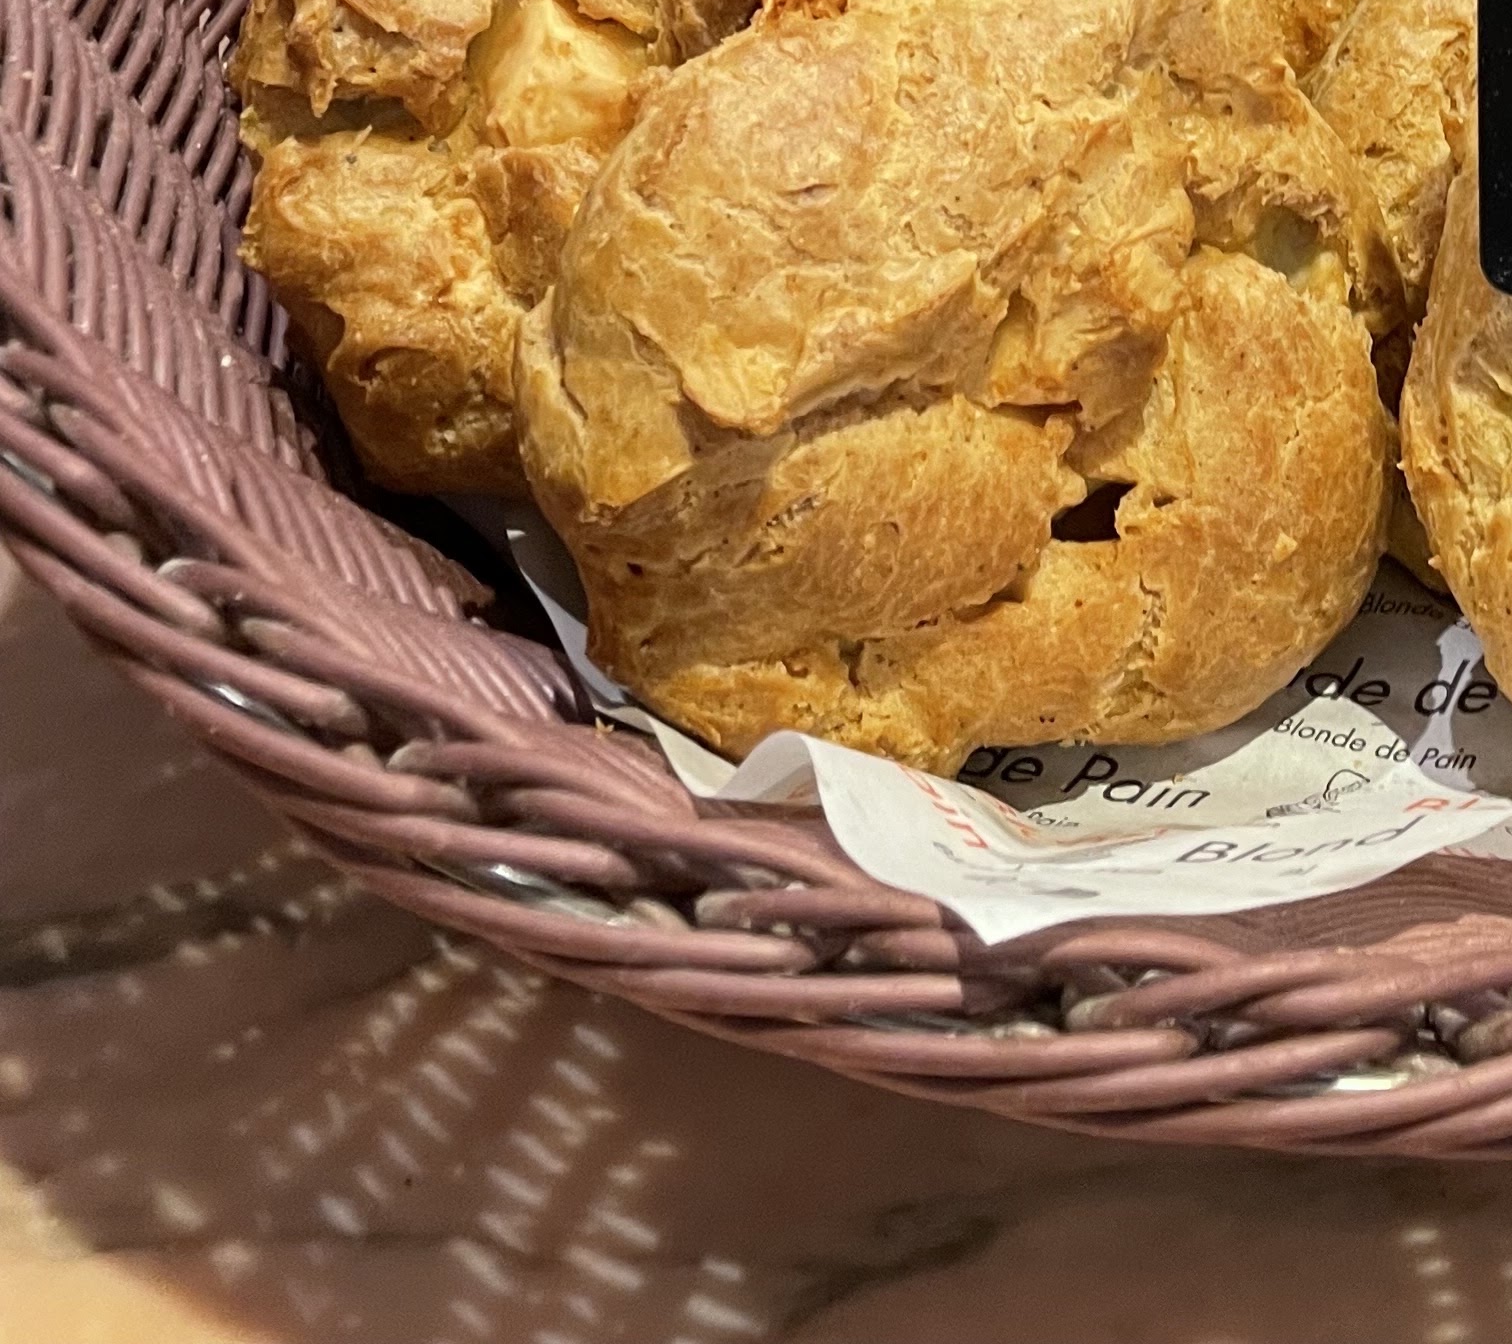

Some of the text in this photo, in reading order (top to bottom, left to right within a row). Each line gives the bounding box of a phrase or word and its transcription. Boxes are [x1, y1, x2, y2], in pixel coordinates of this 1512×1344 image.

[1287, 657, 1498, 716] de de
[1274, 718, 1477, 771] Blonde de Pain
[1060, 752, 1211, 808] Pain
